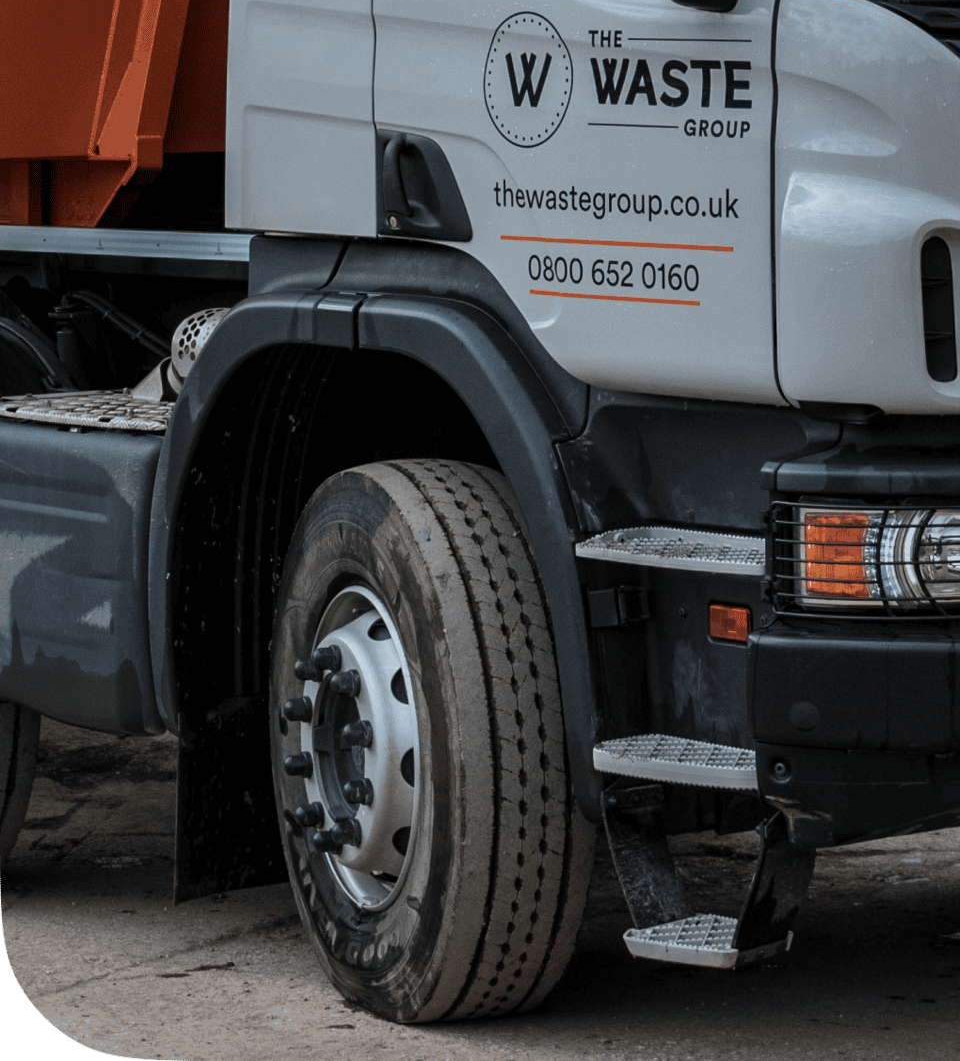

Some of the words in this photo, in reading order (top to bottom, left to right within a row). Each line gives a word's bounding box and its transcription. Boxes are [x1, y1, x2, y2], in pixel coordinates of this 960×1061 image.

[588, 29, 623, 48] THE
[505, 52, 553, 108] W
[590, 57, 753, 110] WASTE
[683, 118, 751, 139] GROUP
[493, 178, 740, 223] thewastegroup.co.uk
[528, 254, 584, 285] 0800
[591, 258, 634, 288] 652
[641, 261, 700, 292] 0160
